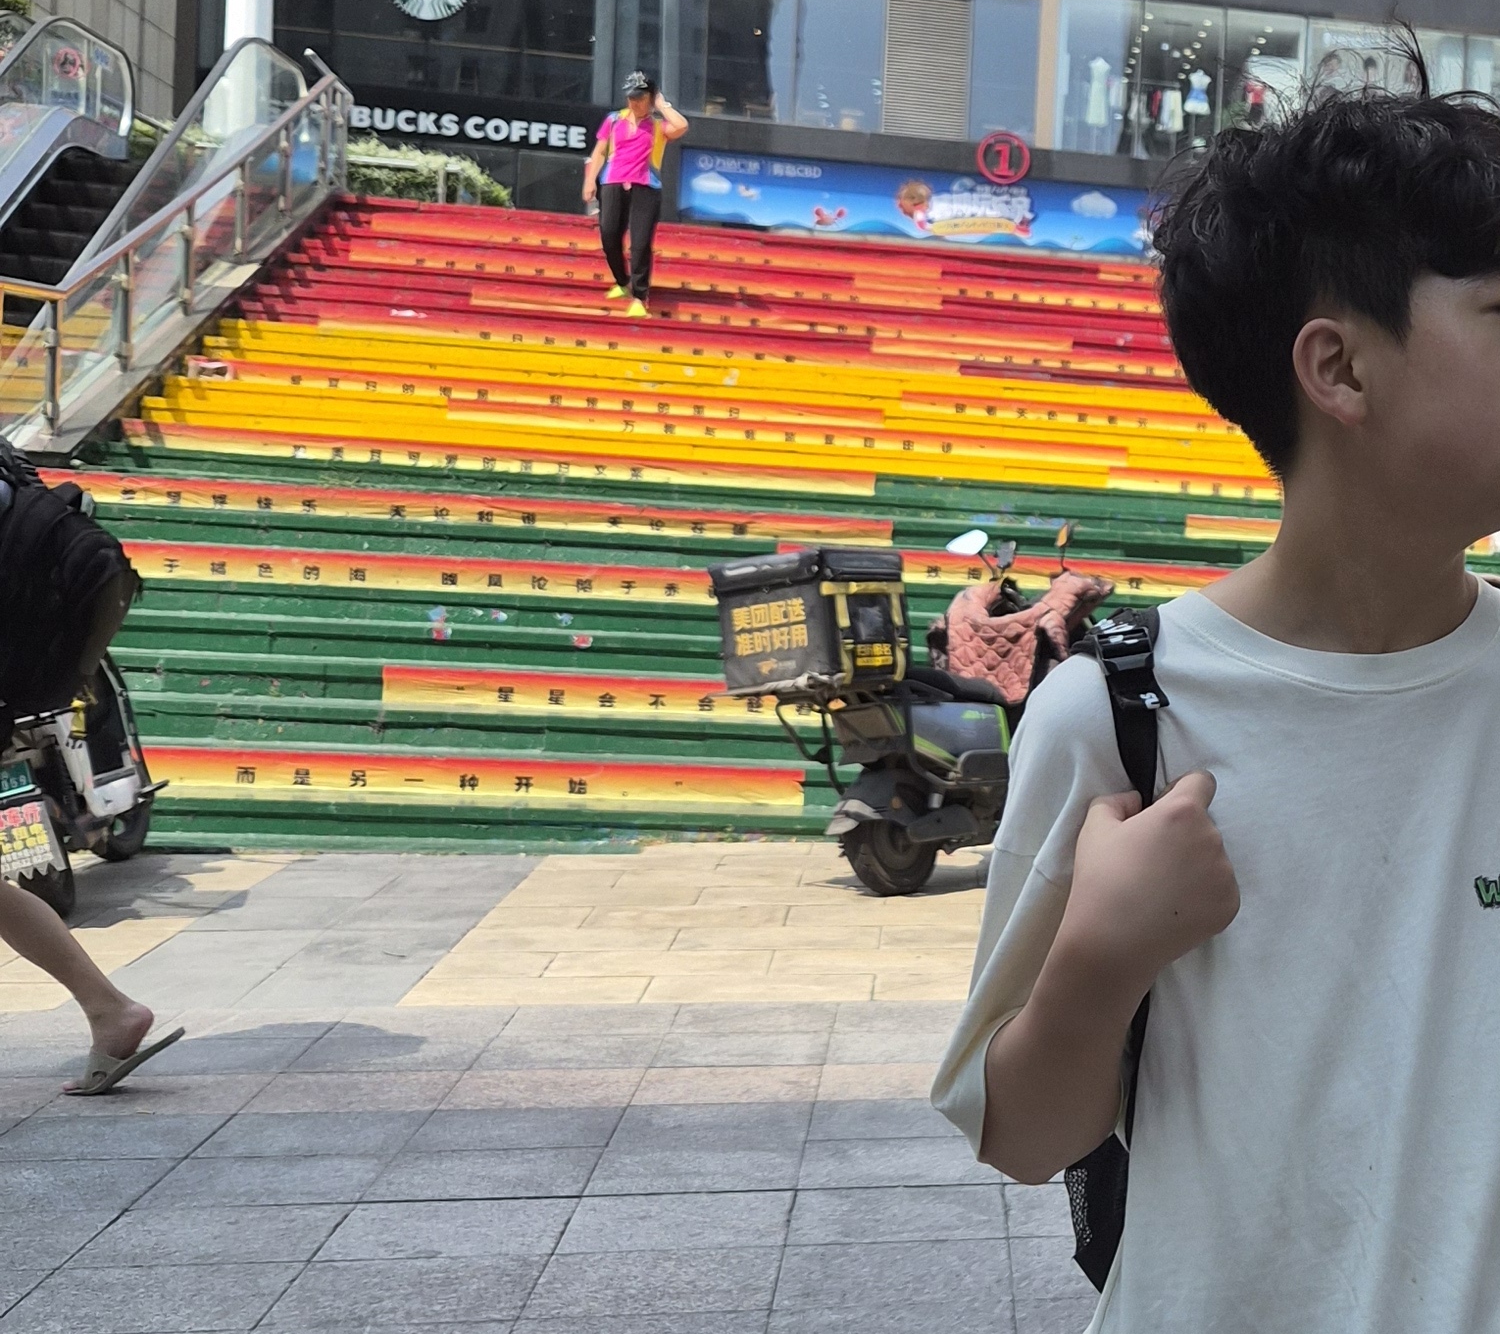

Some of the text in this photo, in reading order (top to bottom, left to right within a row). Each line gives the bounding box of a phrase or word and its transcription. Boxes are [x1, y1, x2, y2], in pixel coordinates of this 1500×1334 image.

[464, 115, 587, 149] COFFEE
[731, 597, 807, 633] 美团配送
[735, 624, 809, 657] 准时好用
